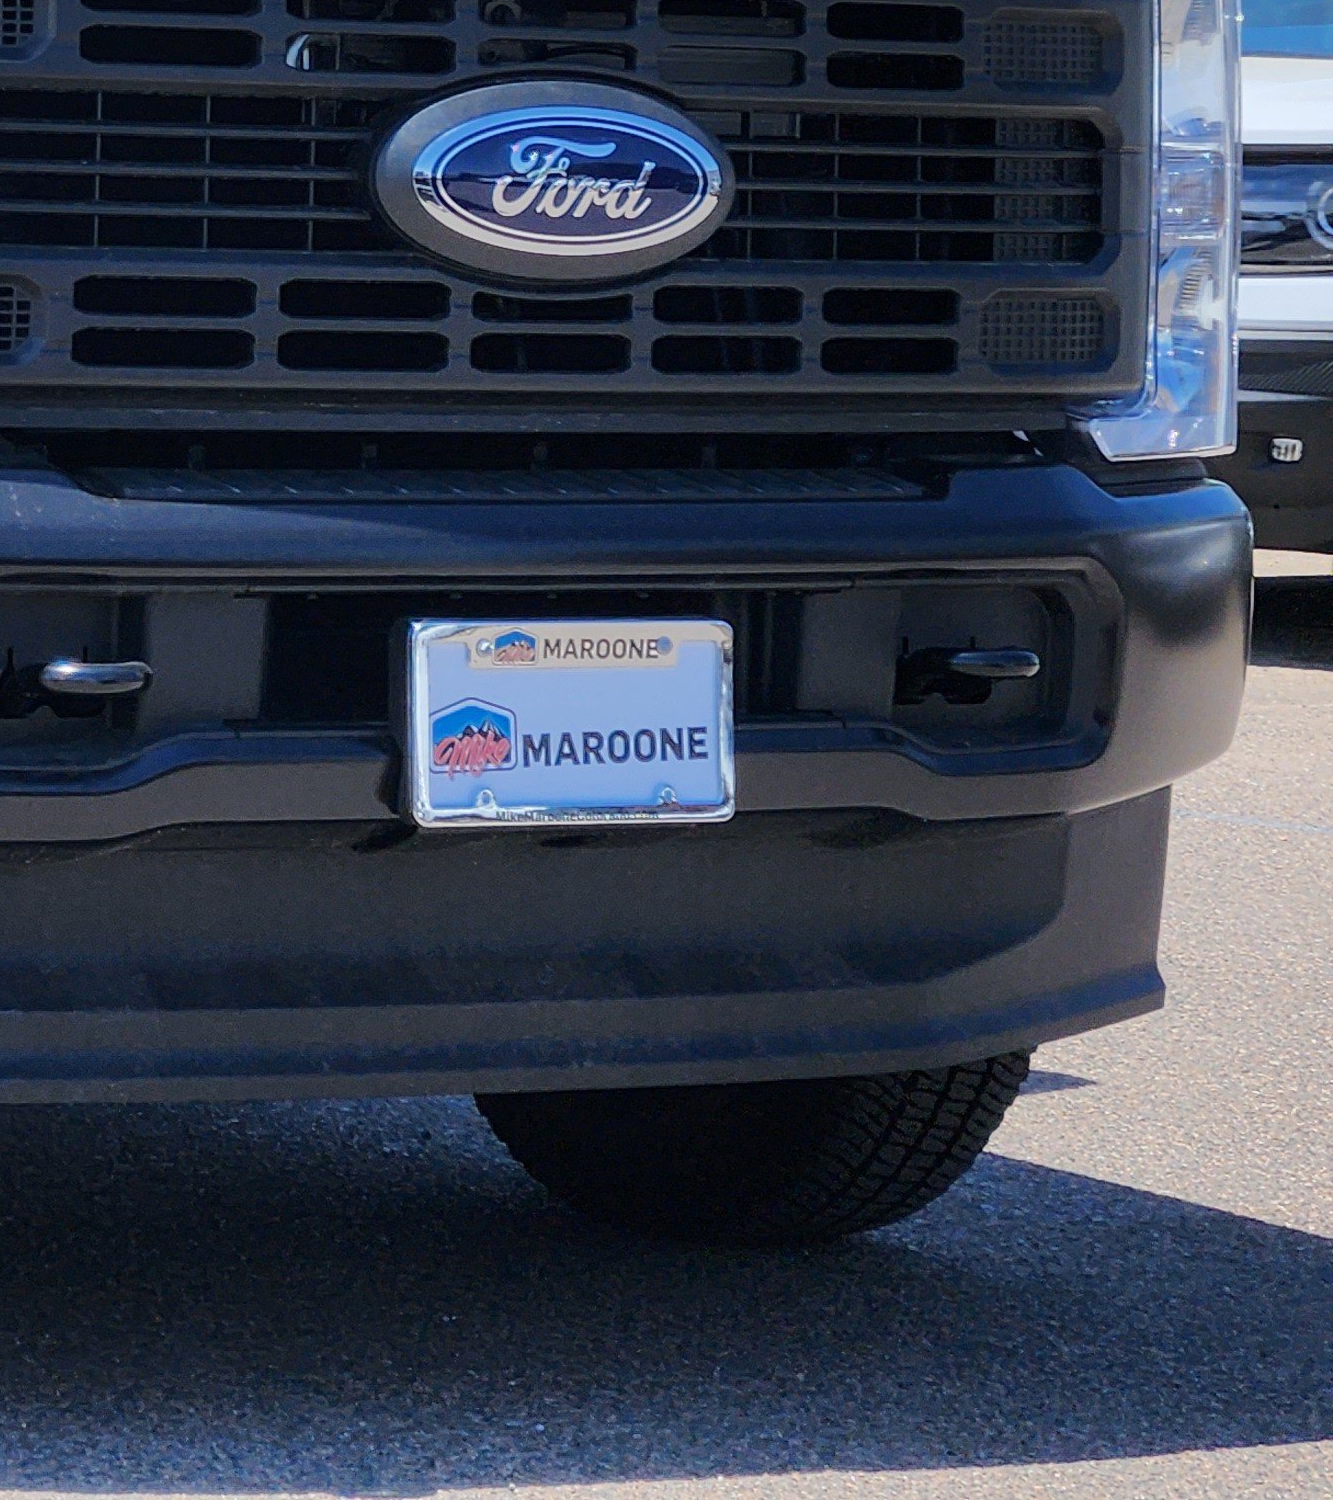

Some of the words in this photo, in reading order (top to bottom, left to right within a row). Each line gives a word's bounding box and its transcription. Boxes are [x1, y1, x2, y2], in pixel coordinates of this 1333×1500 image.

[491, 134, 657, 219] Ford
[543, 638, 659, 659] MAROONE
[522, 726, 709, 768] MAROONE
